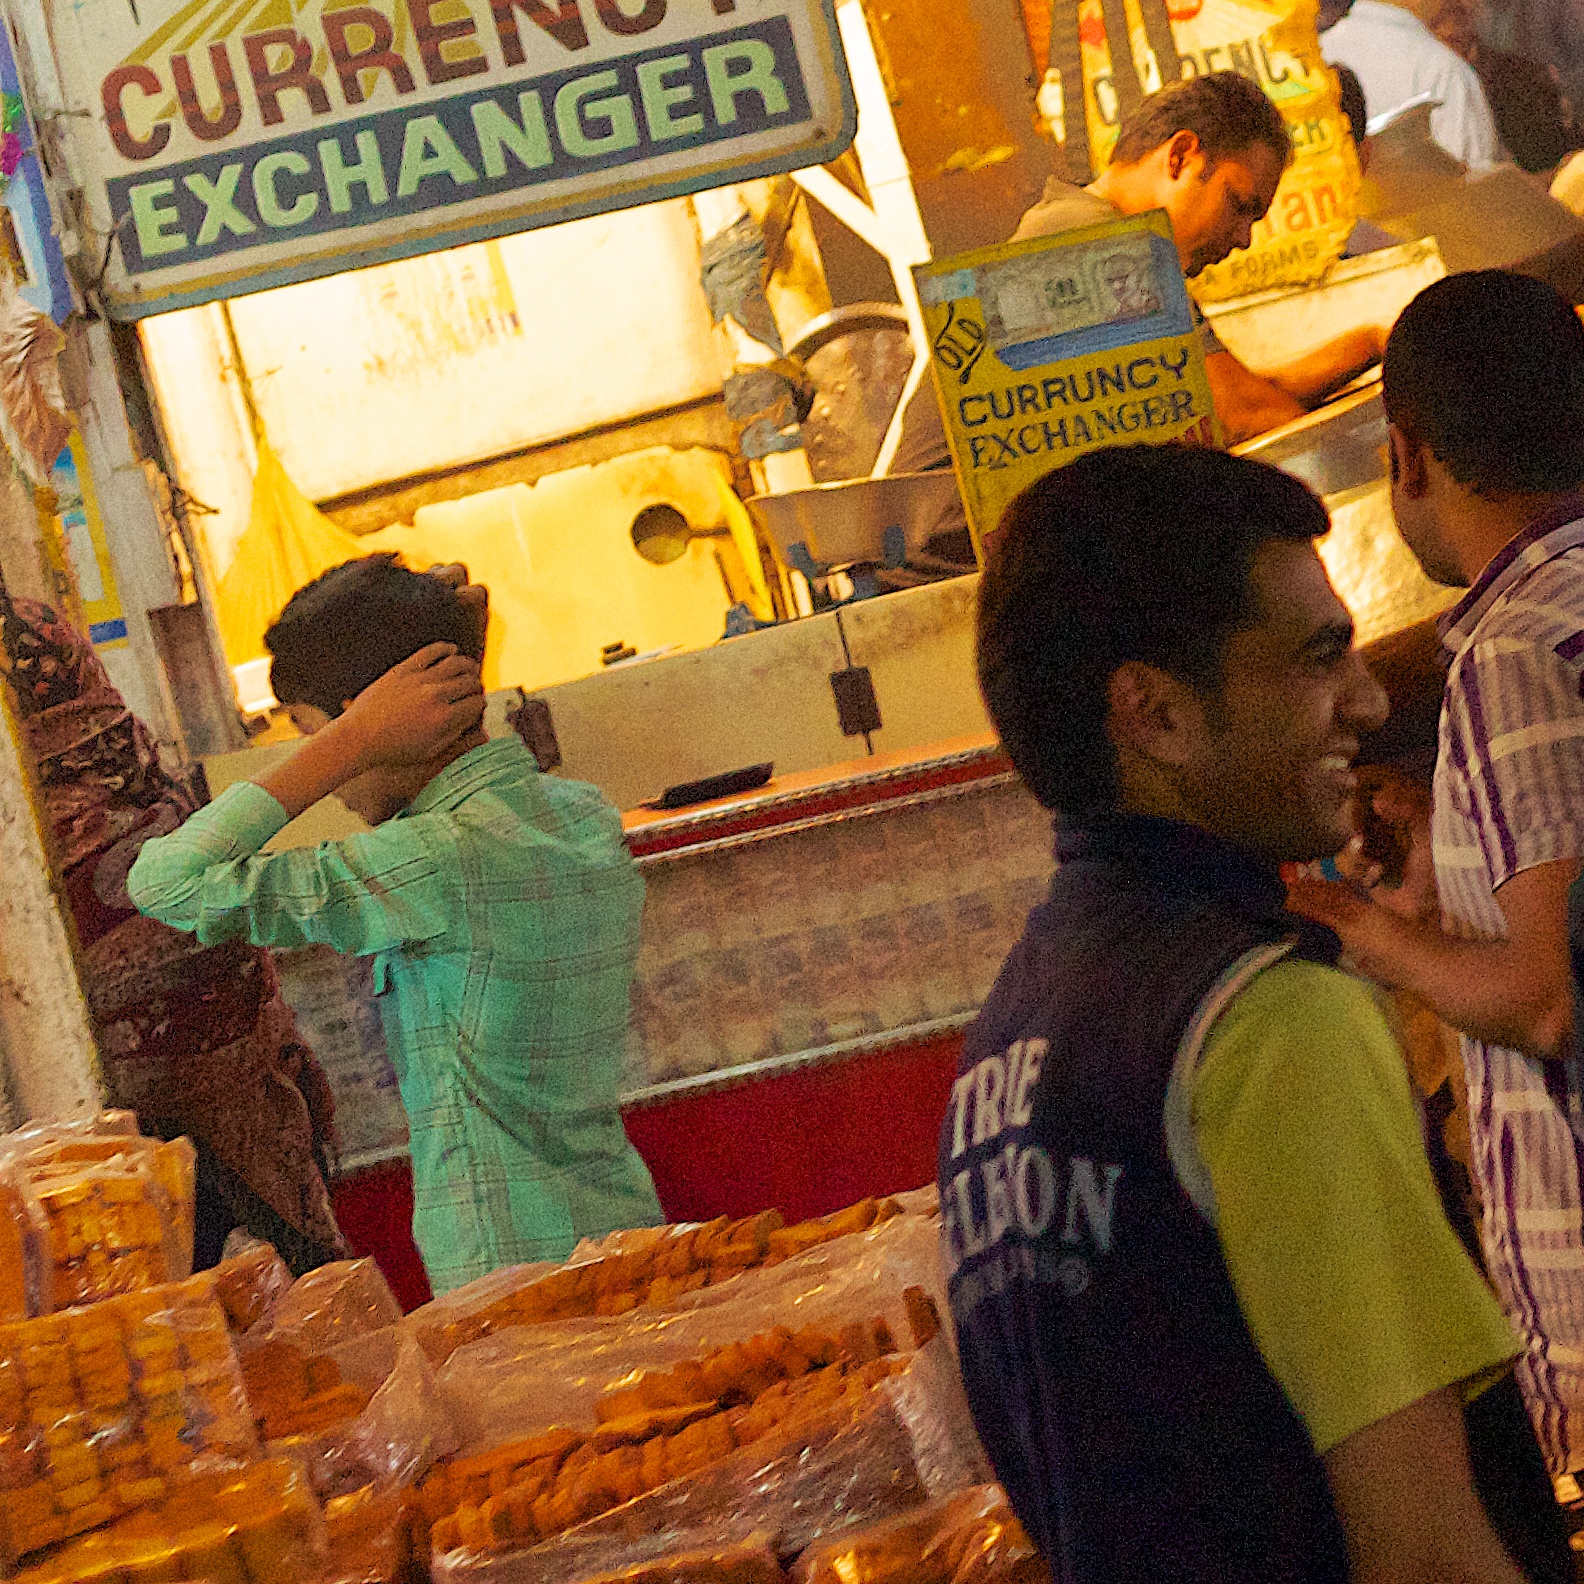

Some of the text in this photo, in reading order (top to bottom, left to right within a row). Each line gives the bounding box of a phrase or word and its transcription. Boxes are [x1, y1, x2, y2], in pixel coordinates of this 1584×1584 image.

[128, 37, 792, 258] EXCHANGER
[957, 348, 1190, 428] CURRUNCY
[967, 388, 1197, 471] EXCHANGER
